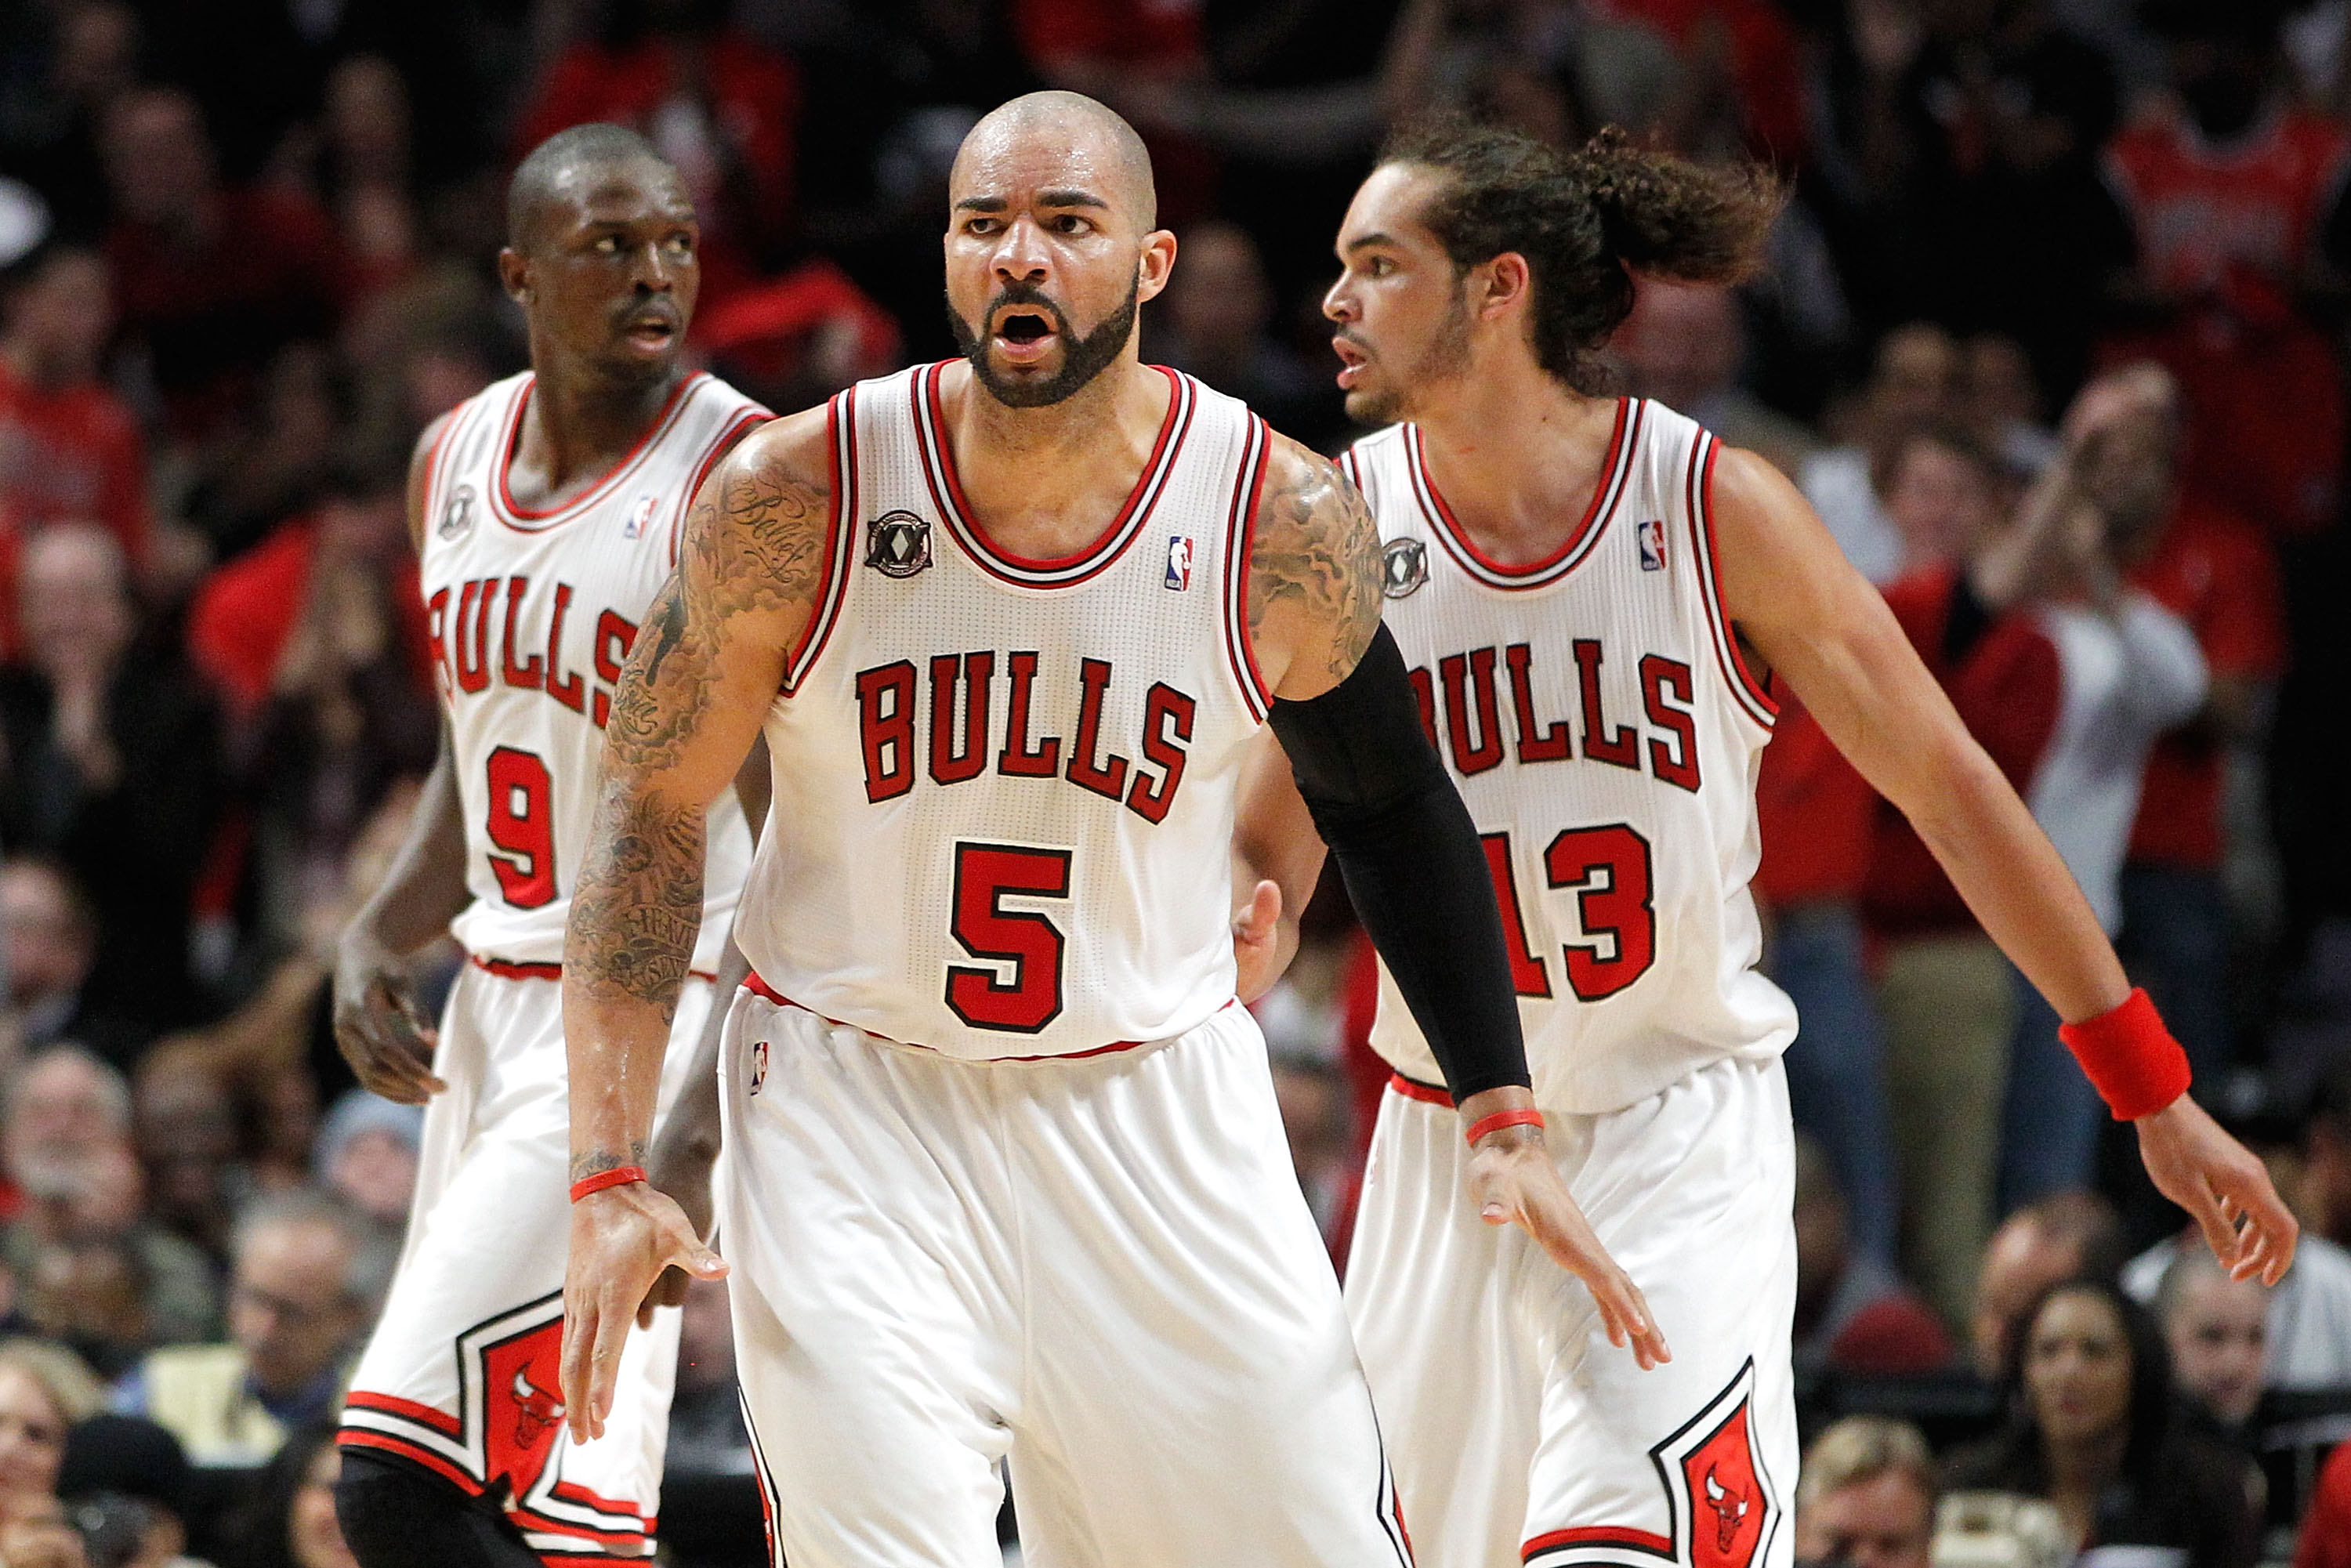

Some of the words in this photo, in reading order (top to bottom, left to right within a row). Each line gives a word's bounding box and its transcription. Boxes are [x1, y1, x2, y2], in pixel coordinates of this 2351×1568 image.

[856, 650, 1197, 825] BULLS
[486, 745, 556, 910] 9
[944, 841, 1074, 1034] 5
